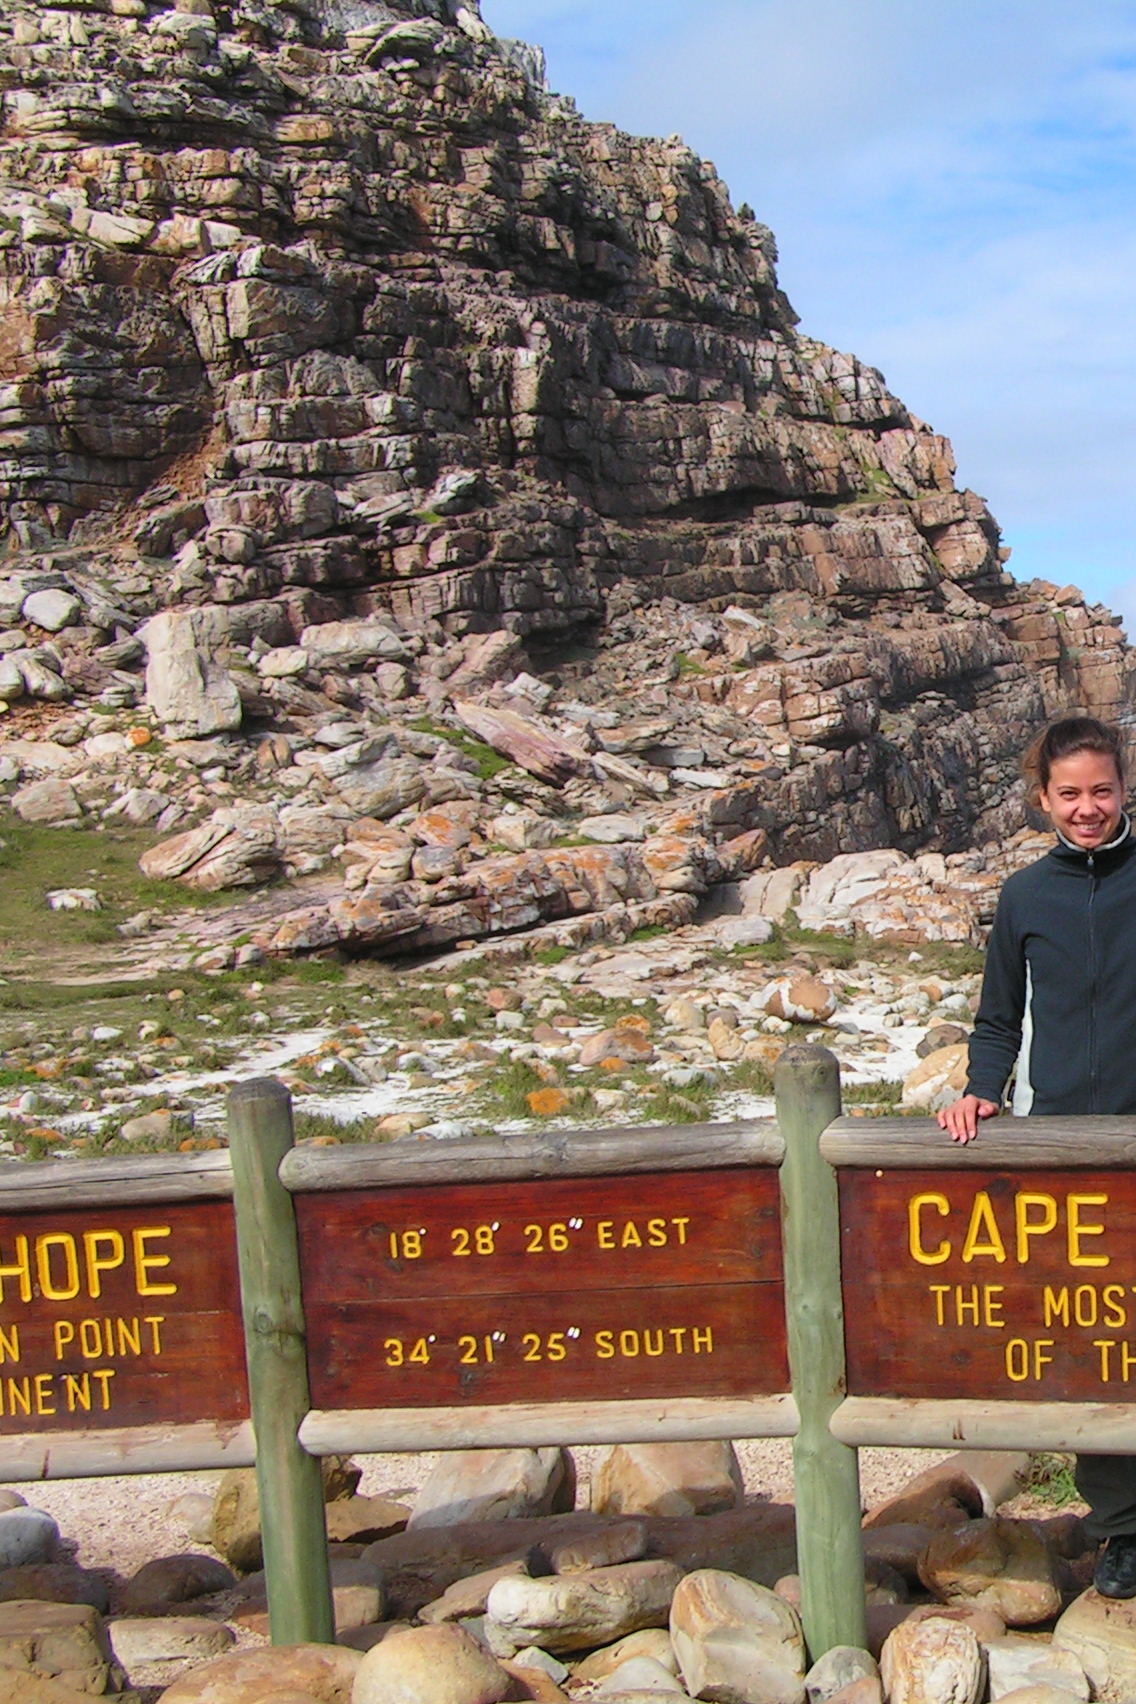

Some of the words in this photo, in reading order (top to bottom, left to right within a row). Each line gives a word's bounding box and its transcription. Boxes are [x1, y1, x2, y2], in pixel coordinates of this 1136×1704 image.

[597, 1216, 690, 1250] EAST
[907, 1191, 1111, 1268] CAPE
[928, 1283, 1006, 1329] THE
[53, 1315, 166, 1361] POINT
[595, 1326, 714, 1359] SOUTH
[1005, 1337, 1055, 1383] OF
